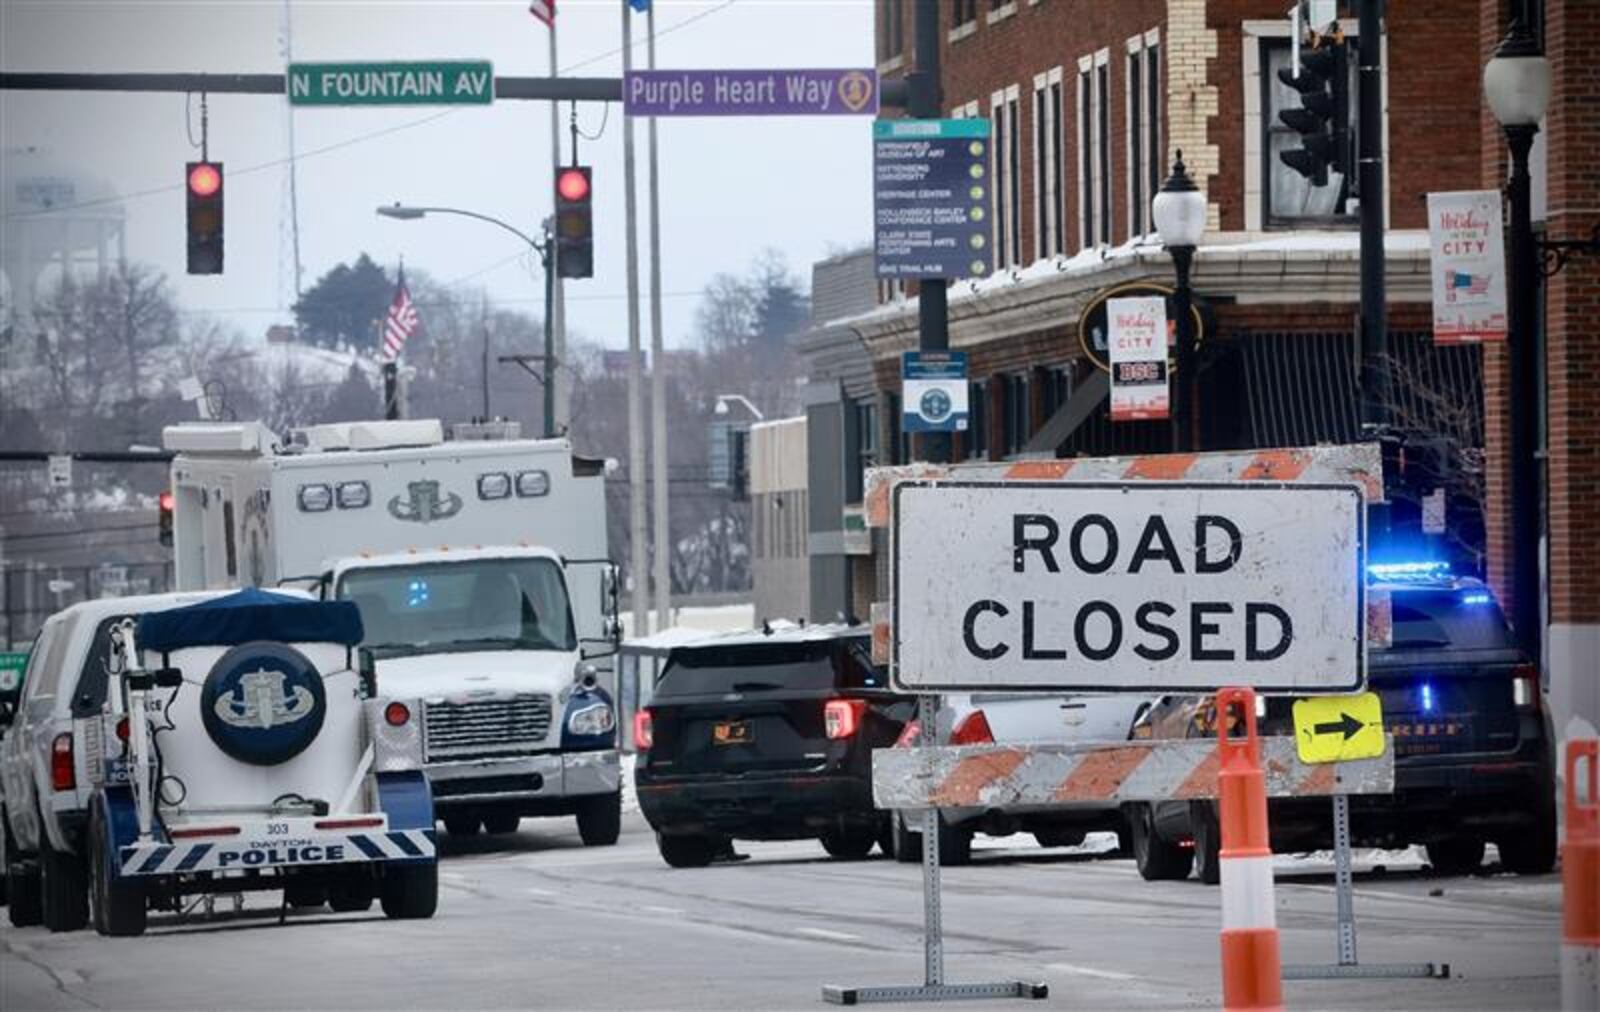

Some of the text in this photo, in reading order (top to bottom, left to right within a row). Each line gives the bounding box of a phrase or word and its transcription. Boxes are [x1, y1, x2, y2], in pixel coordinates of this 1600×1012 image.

[291, 72, 488, 96] N FOUNTAIN AV
[631, 75, 834, 112] Purple Heart Way
[928, 149, 945, 157] ART
[918, 189, 952, 198] CENTER
[934, 215, 967, 224] CENTER
[1440, 208, 1489, 236] Holiday
[934, 239, 956, 247] ARTS
[1443, 241, 1485, 255] CITY
[1119, 338, 1153, 349] CITY
[1013, 513, 1243, 575] ROAD
[963, 600, 1294, 662] CLOSED
[267, 824, 289, 835] 303
[249, 839, 313, 849] DAYTON
[218, 845, 345, 867] POLICE
